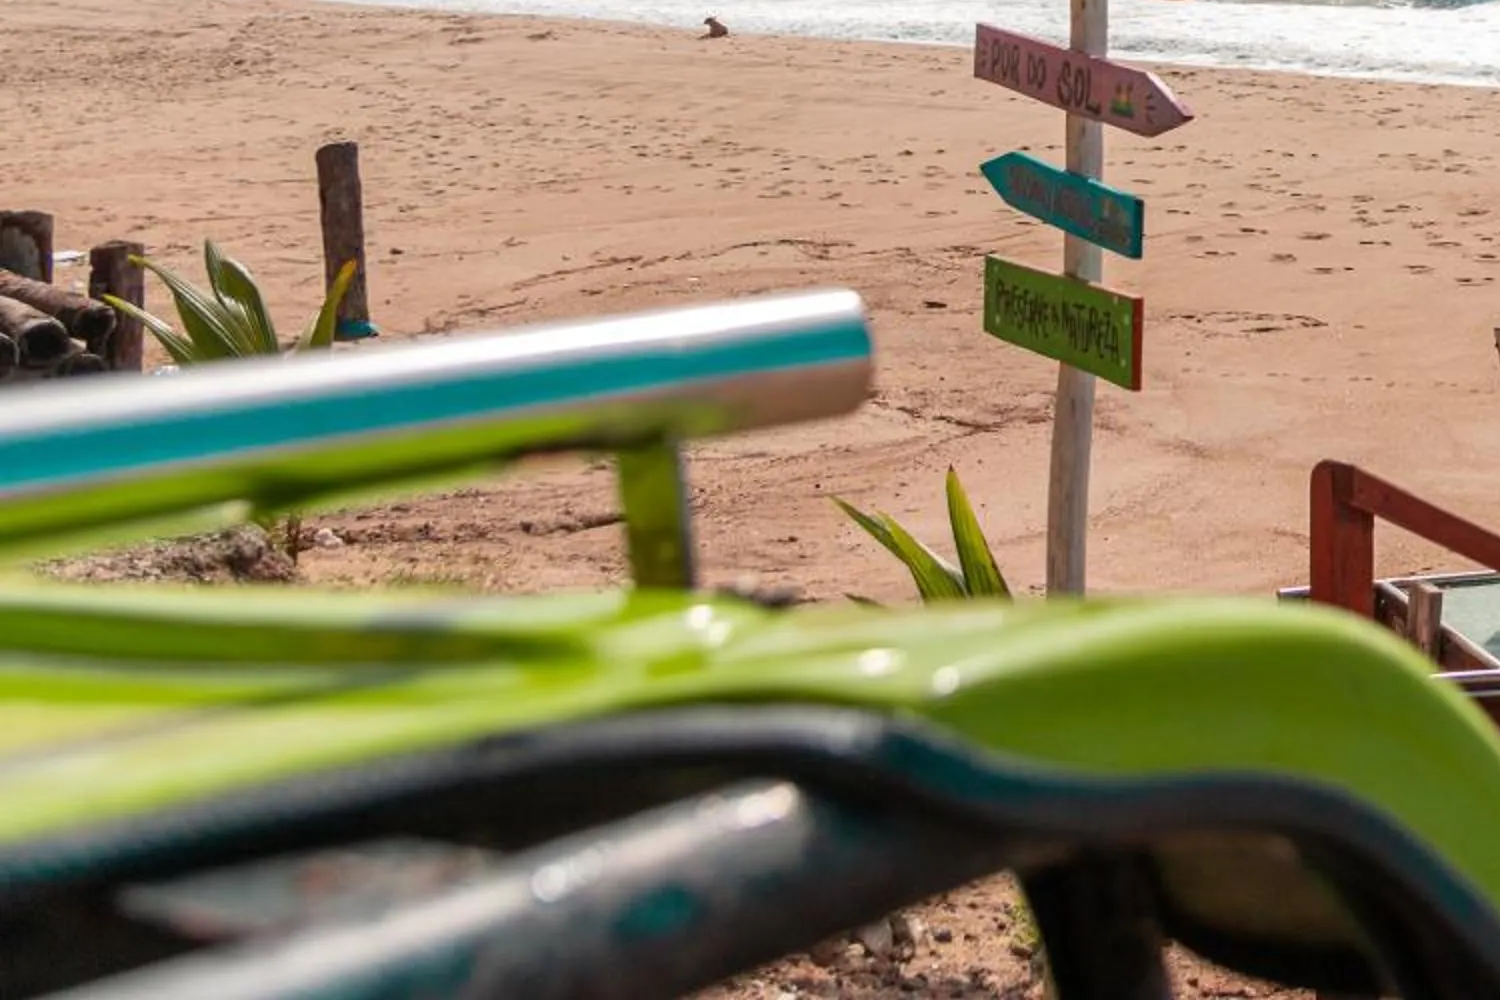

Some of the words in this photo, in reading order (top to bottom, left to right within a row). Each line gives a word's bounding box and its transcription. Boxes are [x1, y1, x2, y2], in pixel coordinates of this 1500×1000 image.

[1026, 50, 1047, 90] DO
[1056, 60, 1102, 116] SOL
[1061, 299, 1121, 367] NATUREZA
